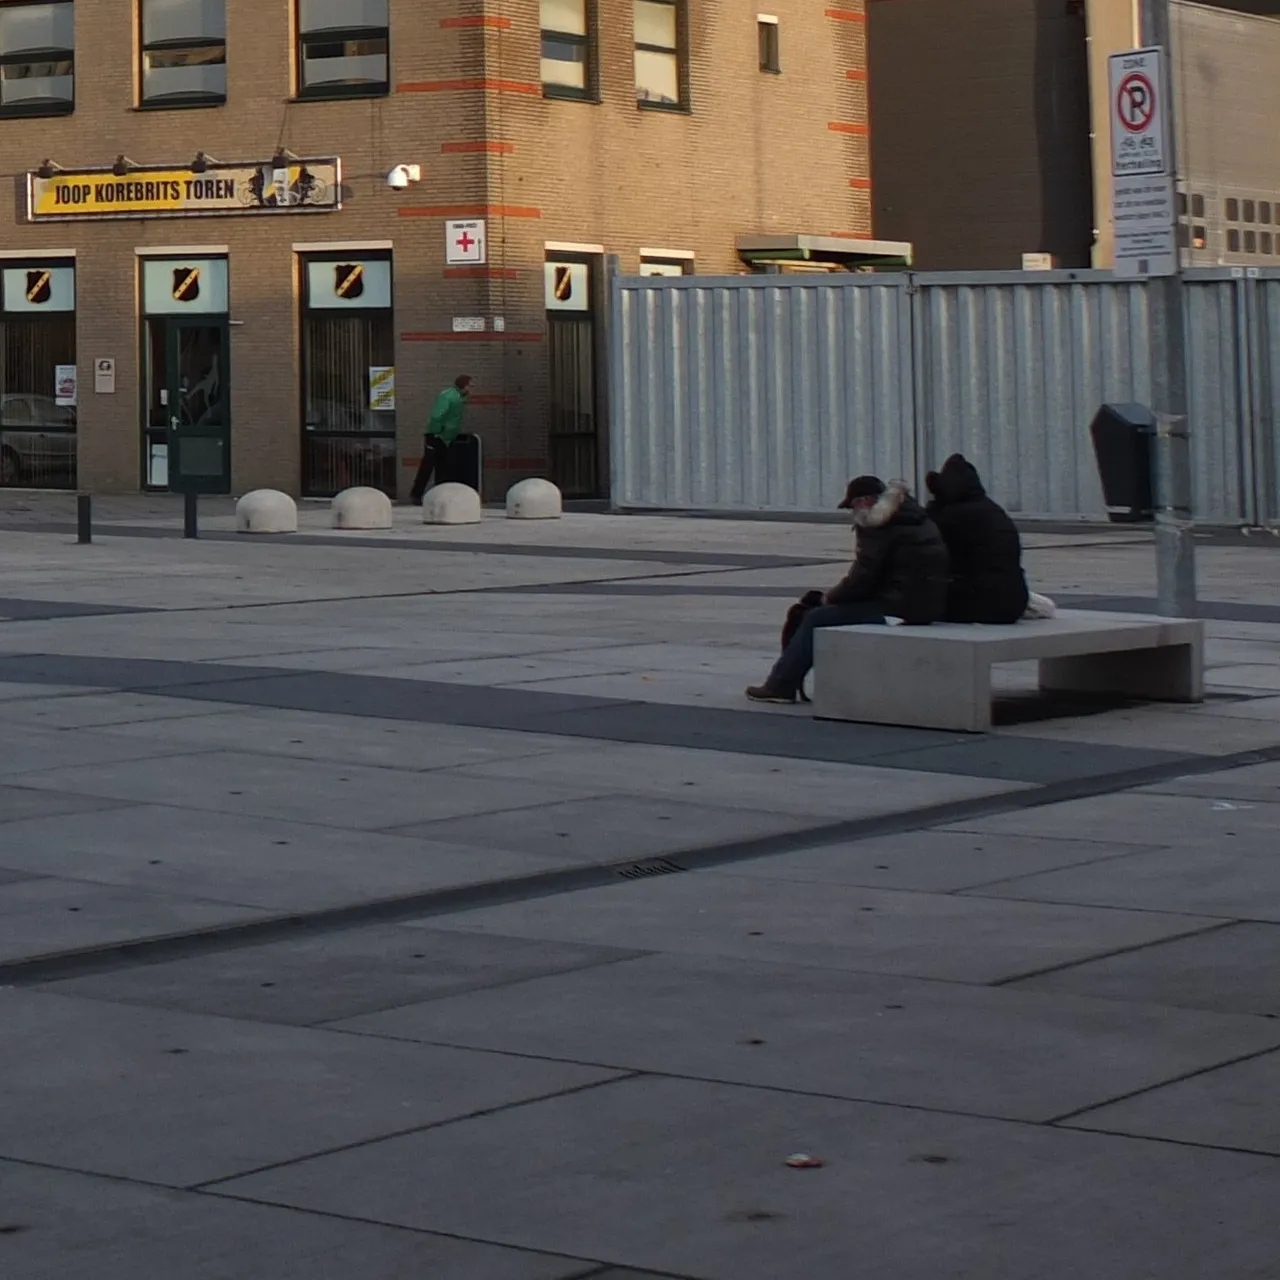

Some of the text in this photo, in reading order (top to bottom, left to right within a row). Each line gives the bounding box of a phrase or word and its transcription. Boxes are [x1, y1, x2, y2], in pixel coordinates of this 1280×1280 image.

[55, 178, 235, 205] JOOP KOREBRITS TOREN
